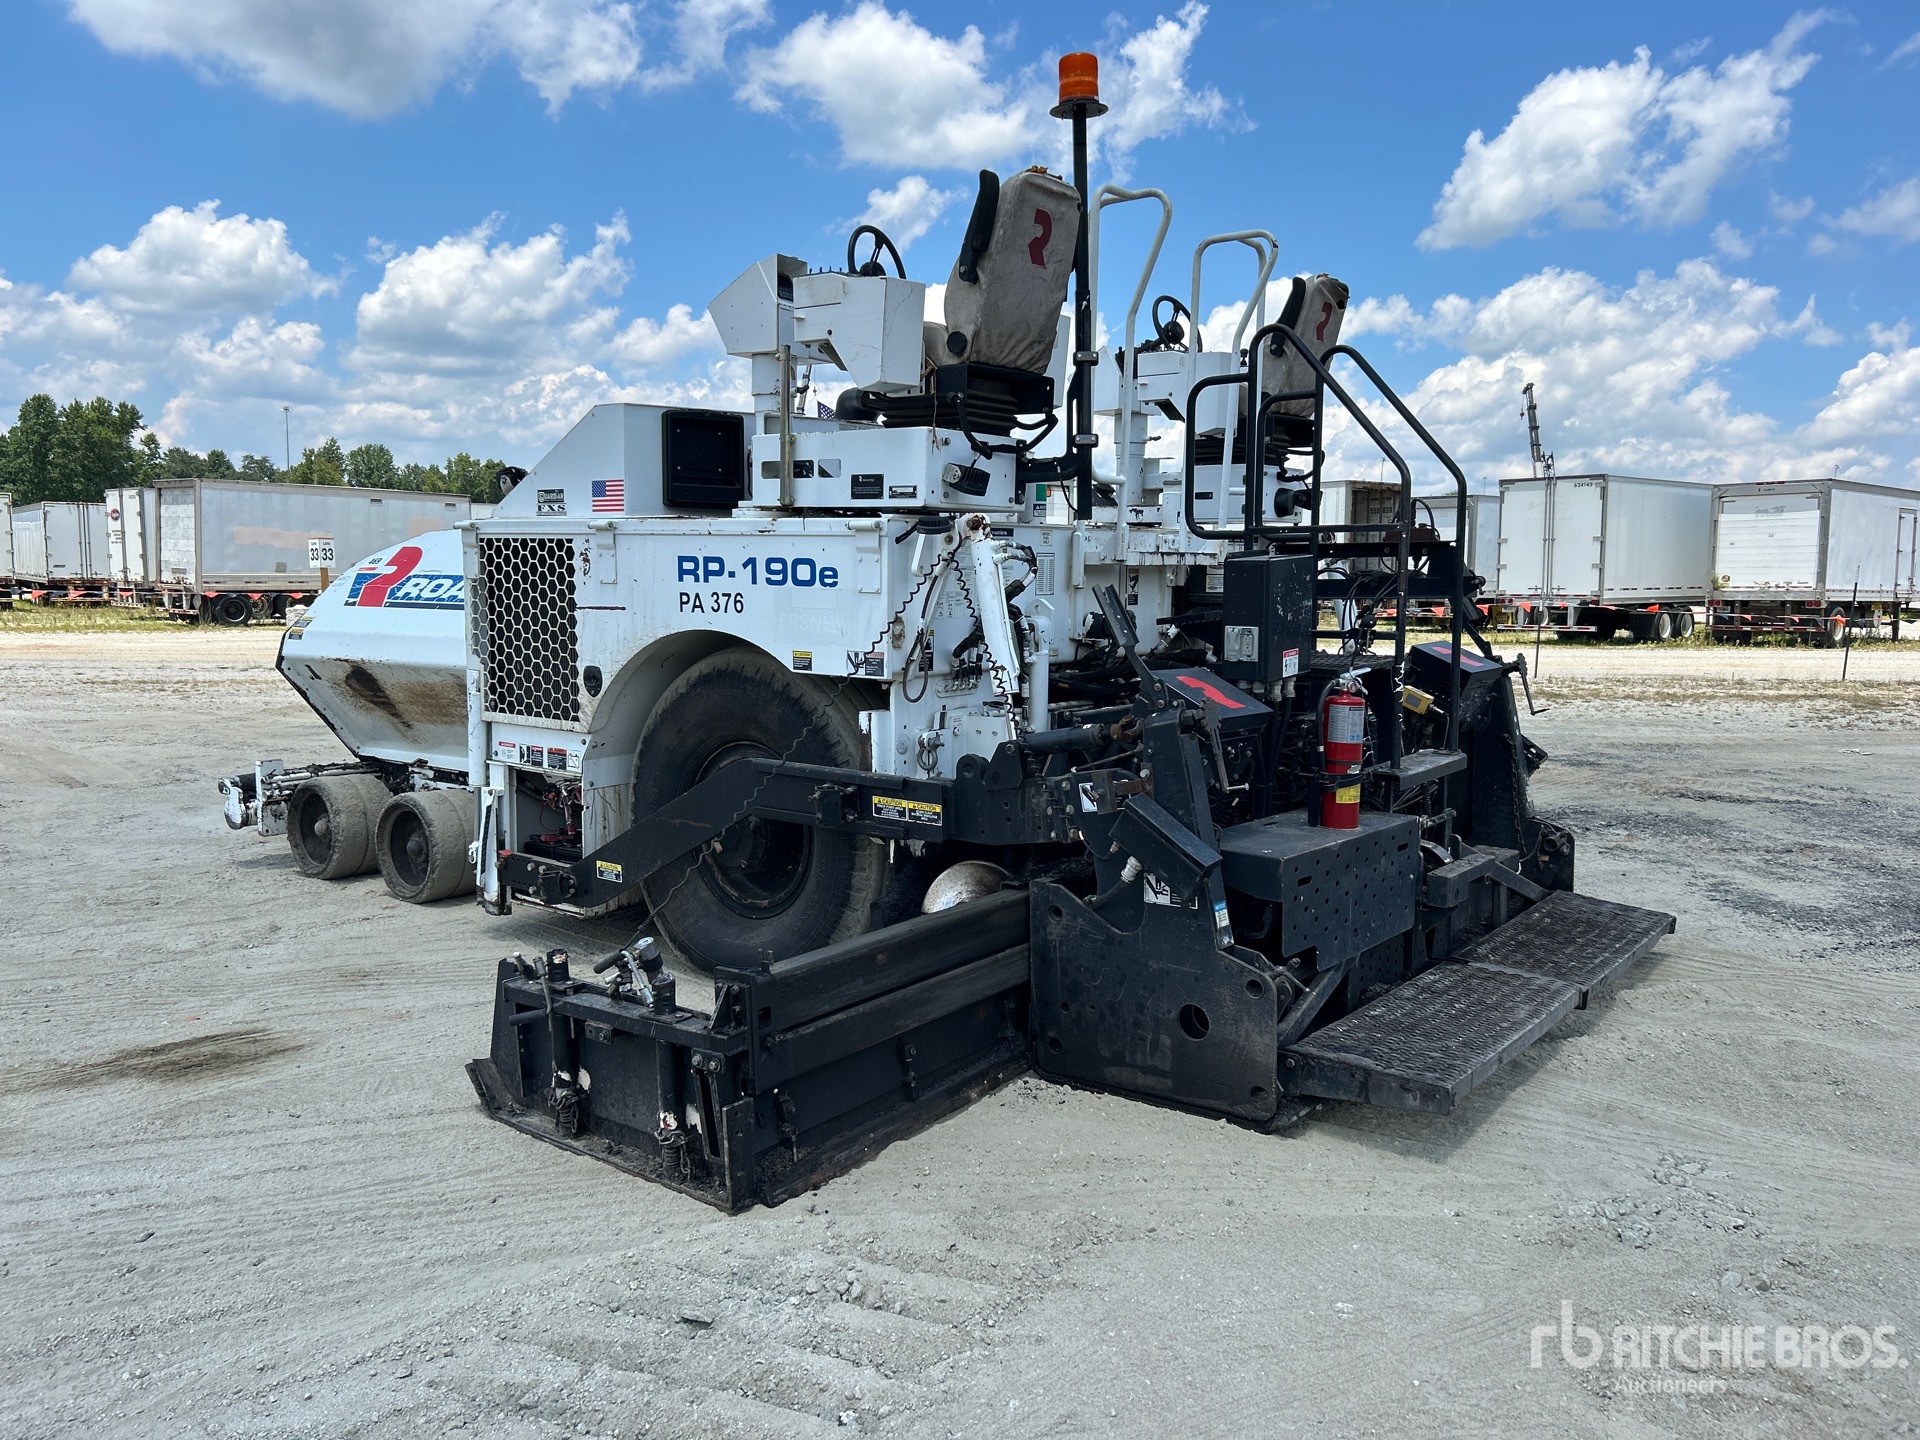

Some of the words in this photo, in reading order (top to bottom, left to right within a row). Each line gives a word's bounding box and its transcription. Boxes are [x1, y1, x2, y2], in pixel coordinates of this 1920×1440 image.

[537, 504, 565, 512] FXS
[310, 548, 319, 561] 33
[321, 548, 334, 561] 33
[677, 555, 839, 588] RP-190e
[679, 592, 705, 614] PA
[711, 592, 744, 614] 376
[882, 798, 903, 806] CAUTION
[917, 803, 937, 811] CAUTION
